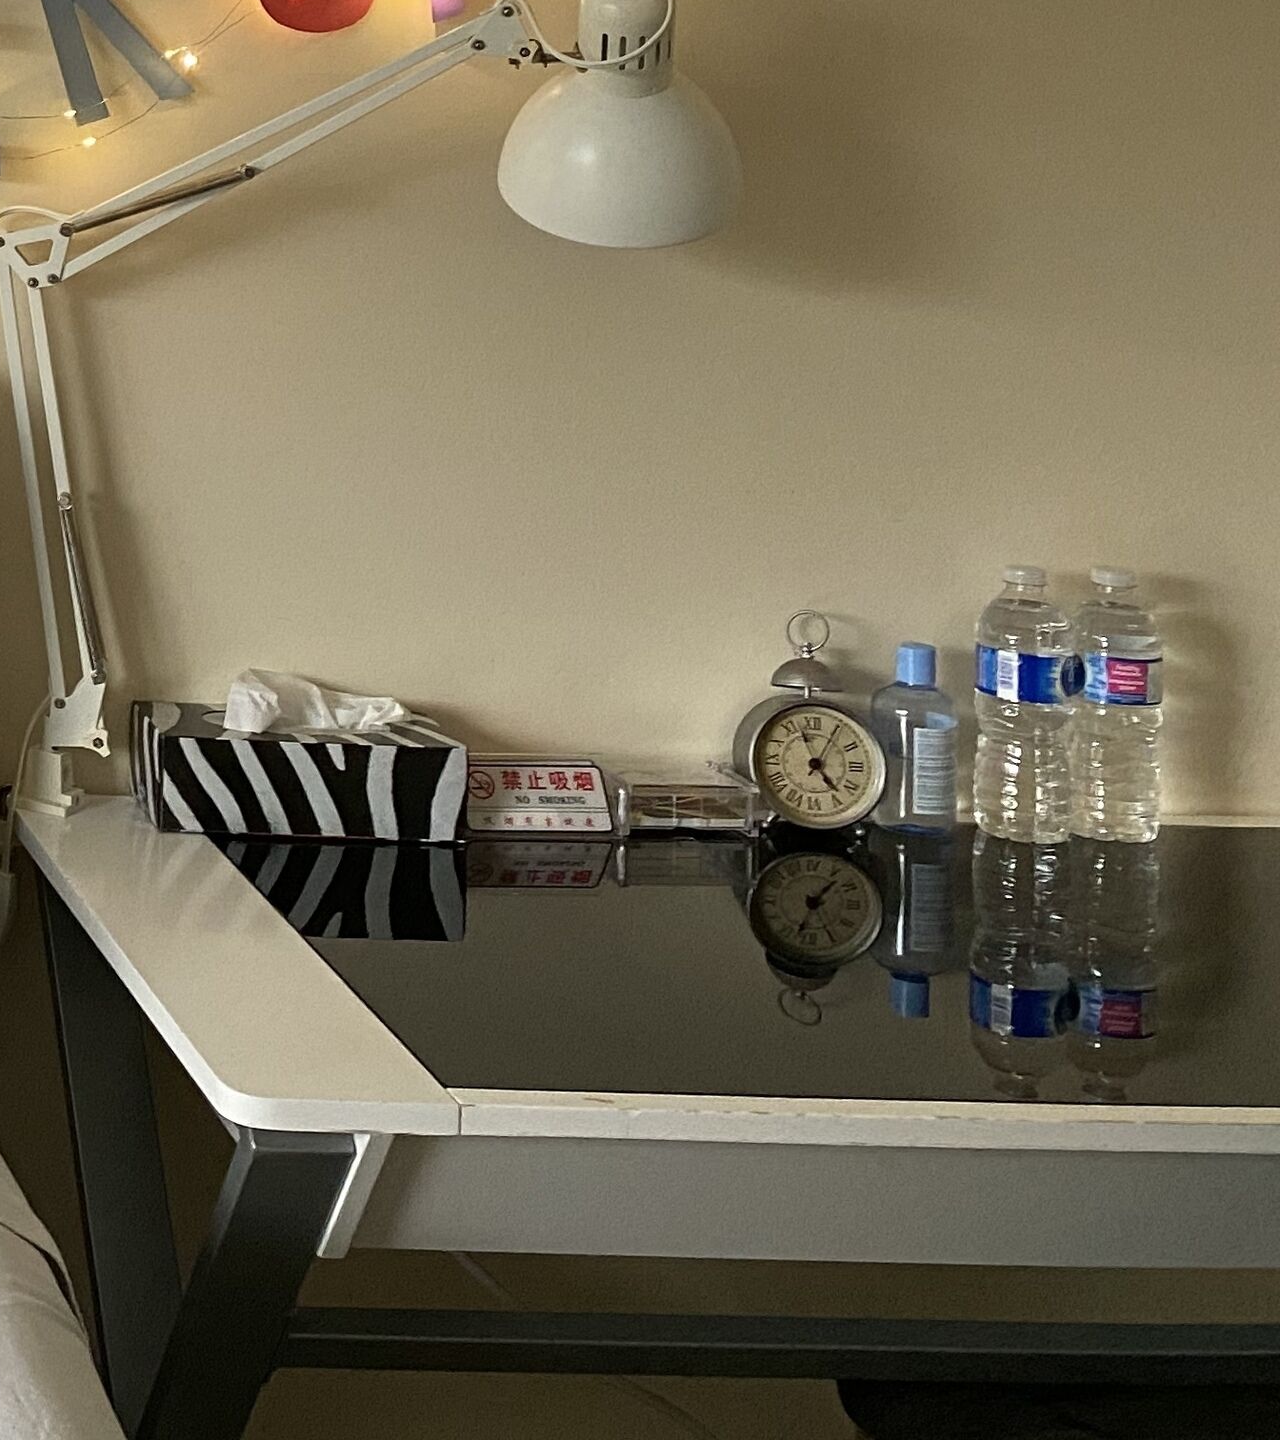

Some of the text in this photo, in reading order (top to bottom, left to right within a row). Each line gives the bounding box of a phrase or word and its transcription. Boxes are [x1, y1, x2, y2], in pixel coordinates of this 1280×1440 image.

[849, 761, 864, 772] III
[501, 771, 594, 791] 禁止吸烟
[514, 795, 586, 806] NO SMOKING
